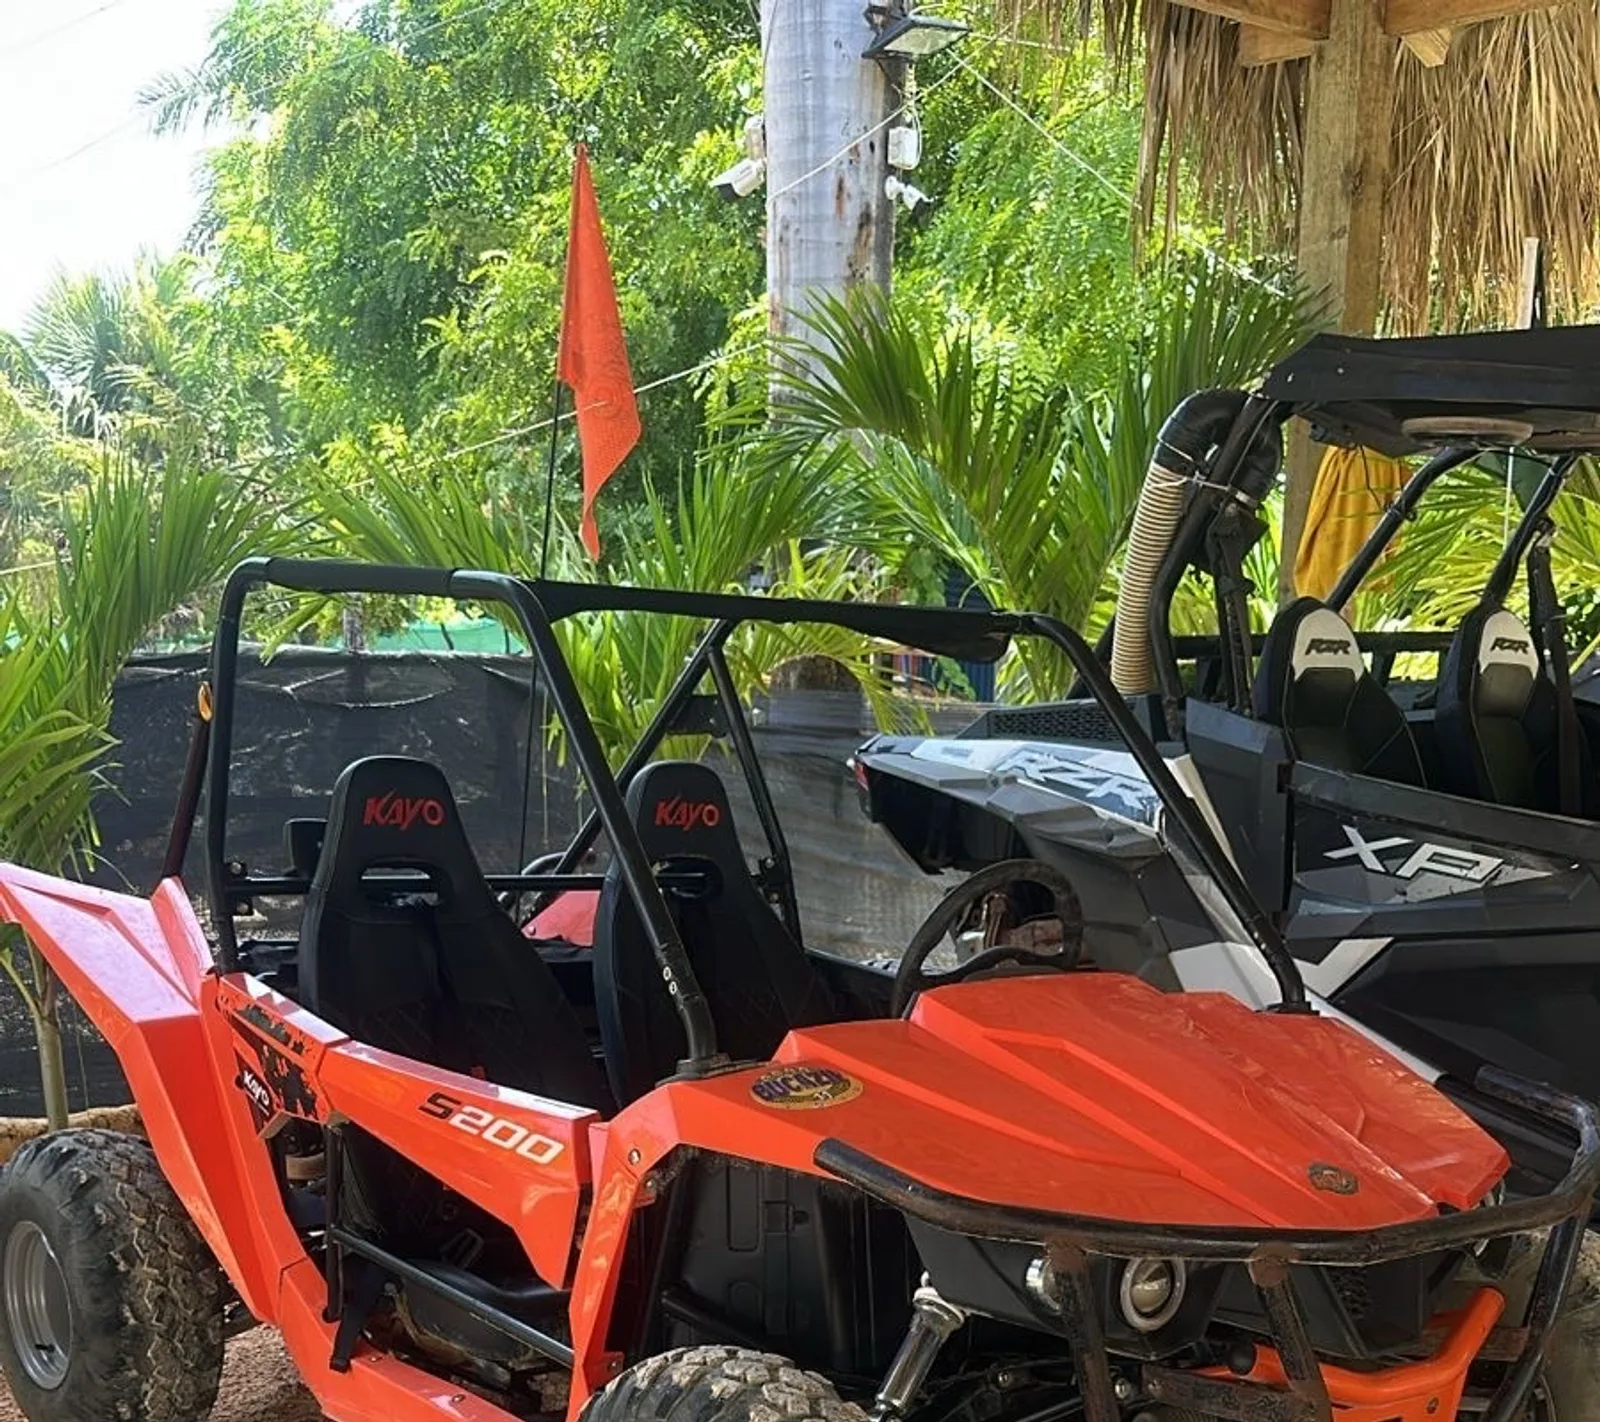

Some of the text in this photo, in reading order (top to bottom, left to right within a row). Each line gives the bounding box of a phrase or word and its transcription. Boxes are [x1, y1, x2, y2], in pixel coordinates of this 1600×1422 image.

[996, 749, 1158, 811] RZR
[1323, 824, 1504, 881] XP
[419, 1092, 565, 1165] S200
